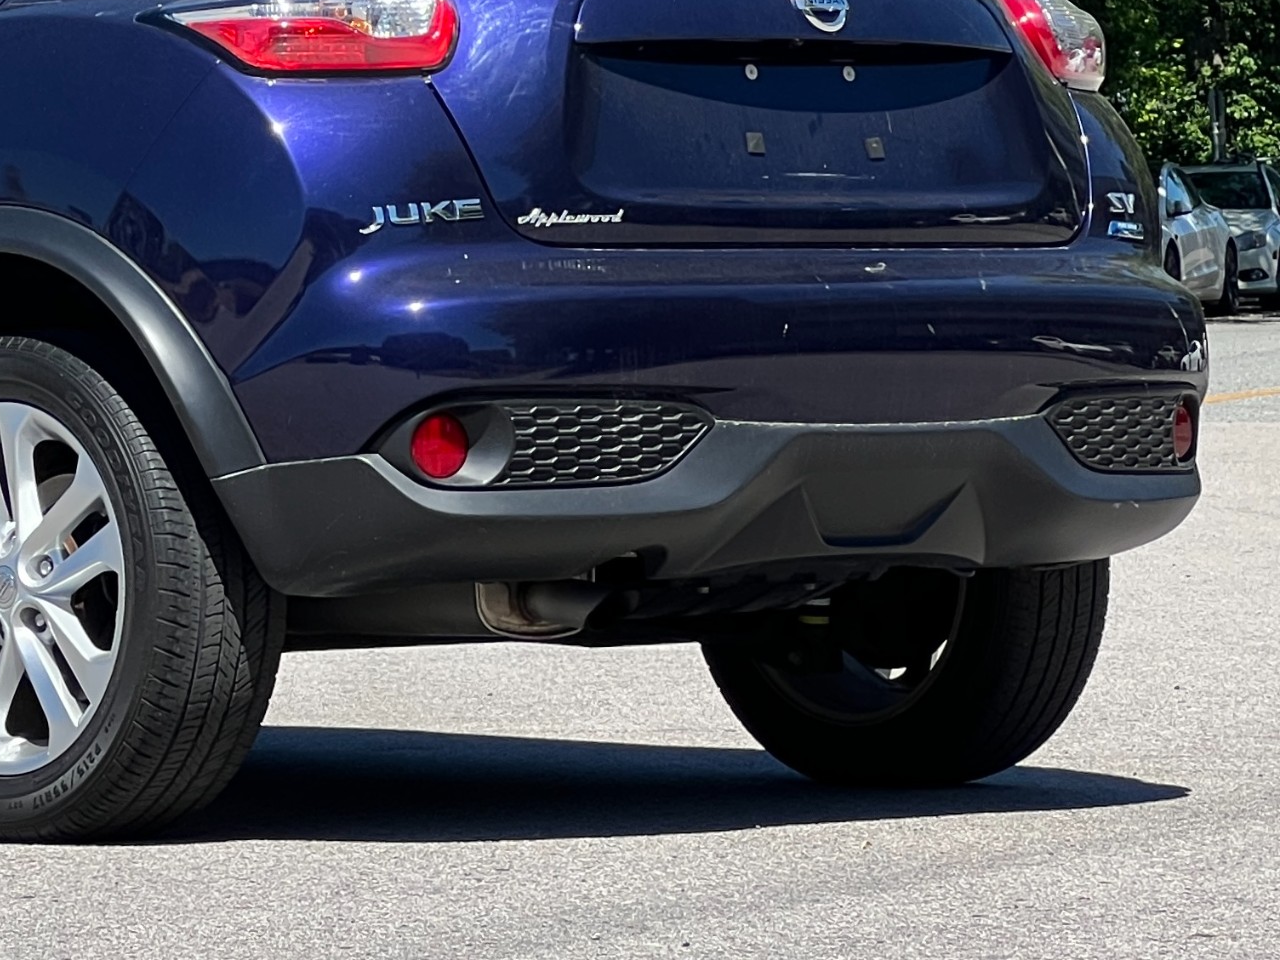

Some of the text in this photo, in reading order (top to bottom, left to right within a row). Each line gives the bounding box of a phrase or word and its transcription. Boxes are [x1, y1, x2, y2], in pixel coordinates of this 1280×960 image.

[1106, 192, 1135, 214] SV
[358, 198, 485, 235] JUKE
[517, 206, 625, 228] Applewood
